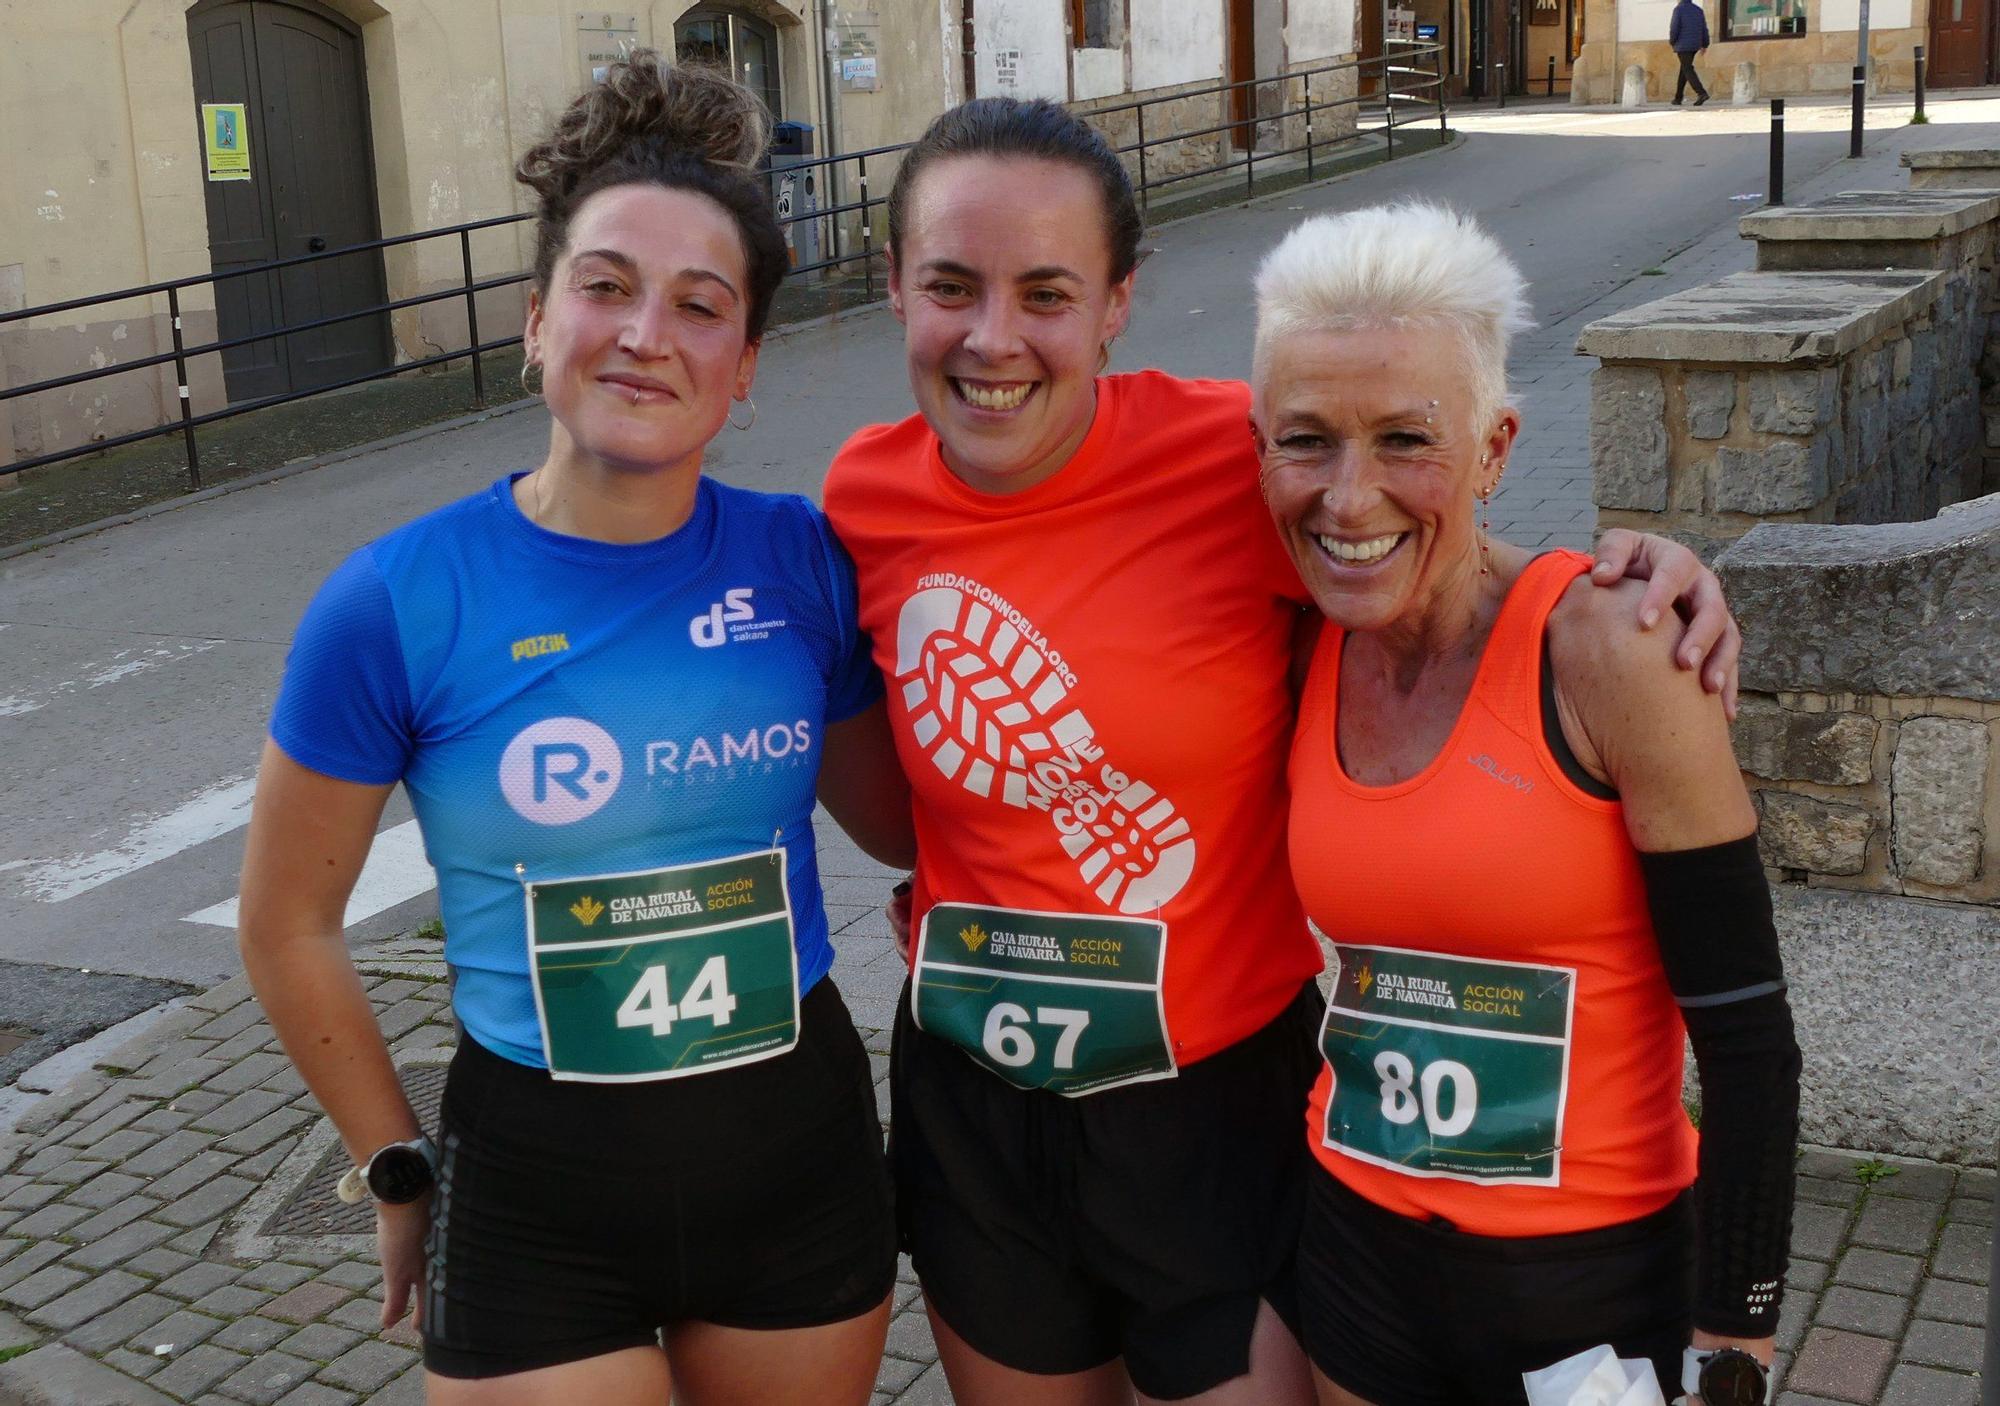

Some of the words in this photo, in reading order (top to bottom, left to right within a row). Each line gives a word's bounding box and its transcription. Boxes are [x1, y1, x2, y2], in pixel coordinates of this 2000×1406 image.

[729, 618, 785, 633] dantzaleku
[917, 573, 1078, 689] FUNDACIONNOELIA.ORG
[733, 630, 769, 643] sakana
[511, 633, 570, 661] POZIK
[646, 720, 811, 775] RAMOS
[1027, 736, 1105, 811] MOVE
[1052, 764, 1129, 835] COL6
[1061, 780, 1095, 803] FOR
[707, 878, 753, 897] ACCIÓN
[609, 895, 647, 911] CAJA
[647, 889, 696, 907] RURAL
[707, 893, 754, 911] SOCIAL
[611, 909, 633, 924] DE
[636, 901, 703, 921] NAVARRA
[991, 931, 1016, 945] CAJA
[1018, 934, 1059, 949] RURAL
[1071, 938, 1121, 952] ACCIÓN
[990, 943, 1005, 955] DE
[1006, 945, 1065, 962] NAVARRA
[1070, 951, 1120, 966] SOCIAL
[1376, 973, 1405, 988] CAJA
[1407, 976, 1451, 994] RURAL
[1464, 984, 1524, 1001] ACCIÓN
[617, 955, 736, 1037] 44
[1376, 985, 1394, 1000] DE
[1396, 989, 1457, 1009] NAVARRA
[1463, 999, 1521, 1017] SOCIAL
[982, 1002, 1090, 1069] 67
[702, 1037, 783, 1060] www.cajaruraldenavarra.com
[1373, 1050, 1478, 1137] 80
[1429, 1160, 1533, 1174] www.cajaruraldenavarra.com
[1752, 1280, 1778, 1291] COMP
[1746, 1293, 1774, 1303] RESS
[1749, 1306, 1764, 1315] OR
